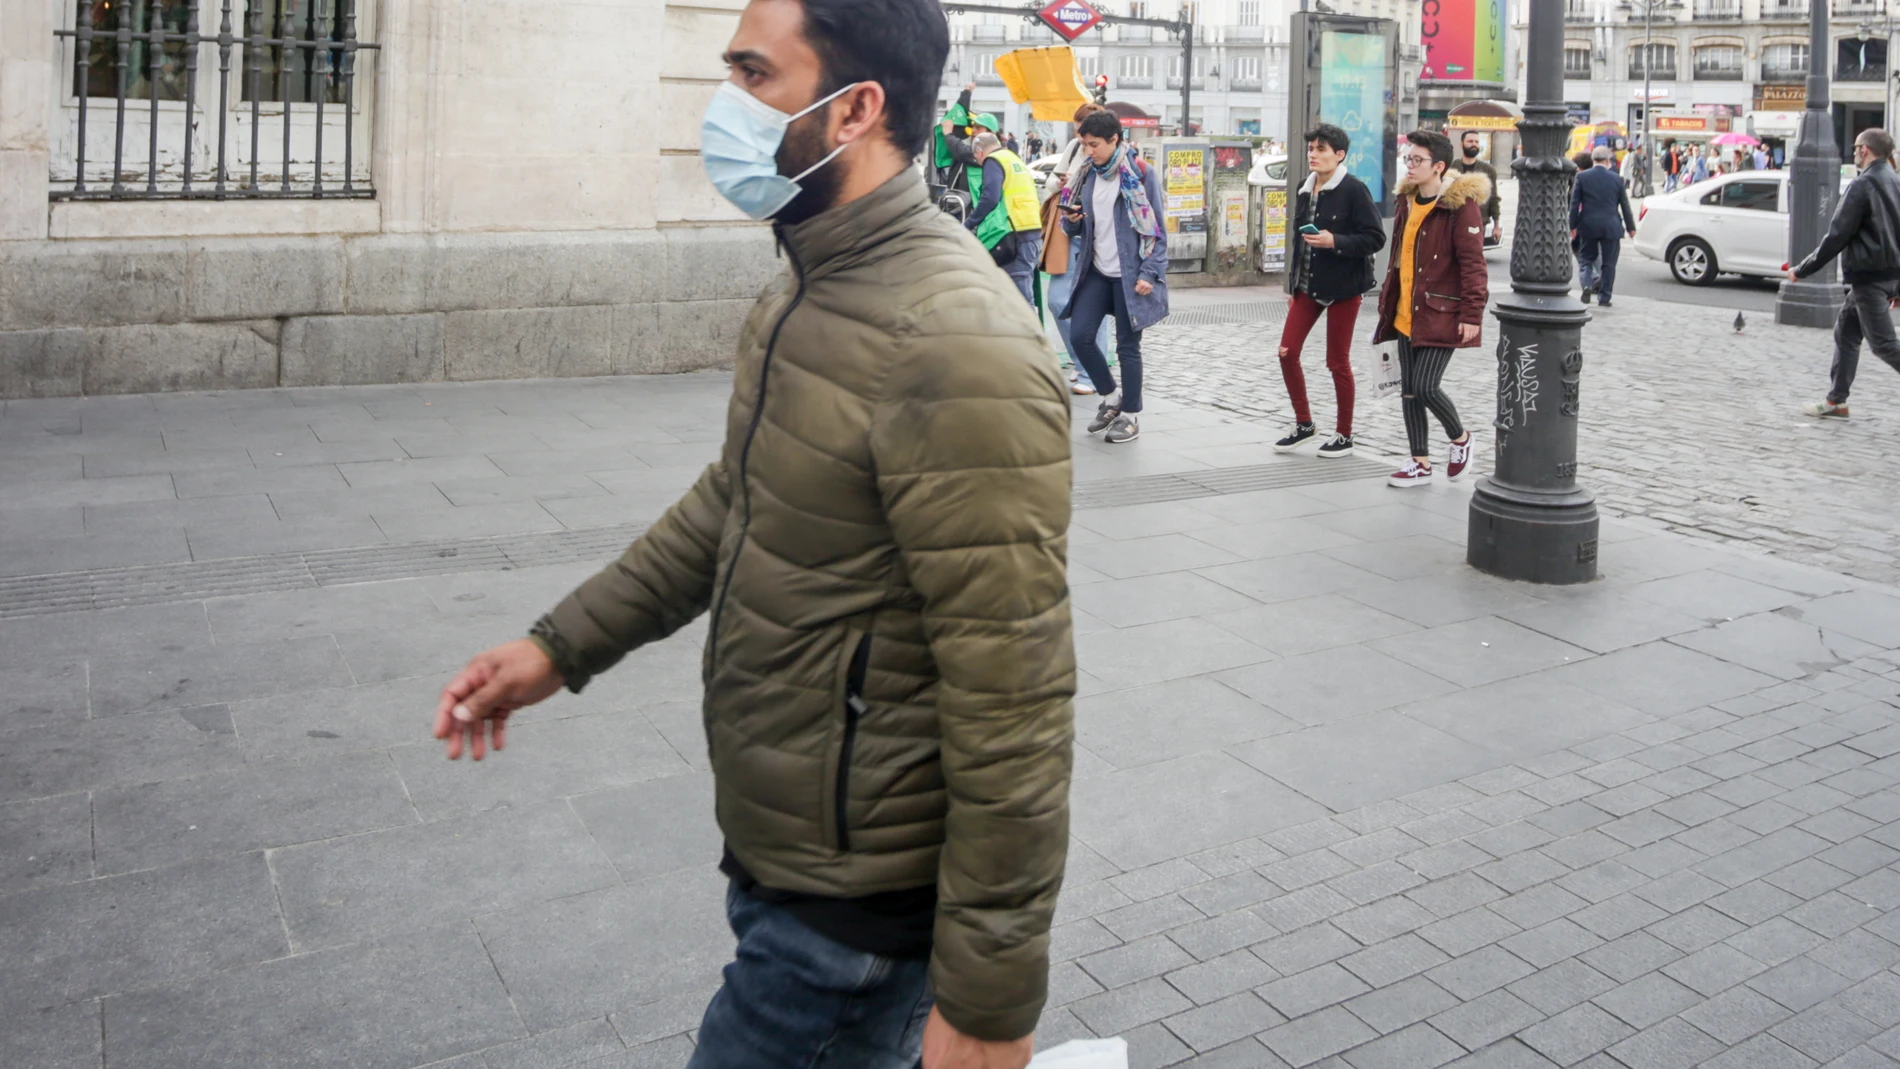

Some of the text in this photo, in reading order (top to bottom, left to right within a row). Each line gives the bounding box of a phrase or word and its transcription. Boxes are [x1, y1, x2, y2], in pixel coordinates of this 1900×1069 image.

[1060, 9, 1087, 21] Metro
[1634, 88, 1668, 97] PRMOR
[1672, 120, 1703, 128] TABACOS
[1169, 151, 1202, 159] COMPRO
